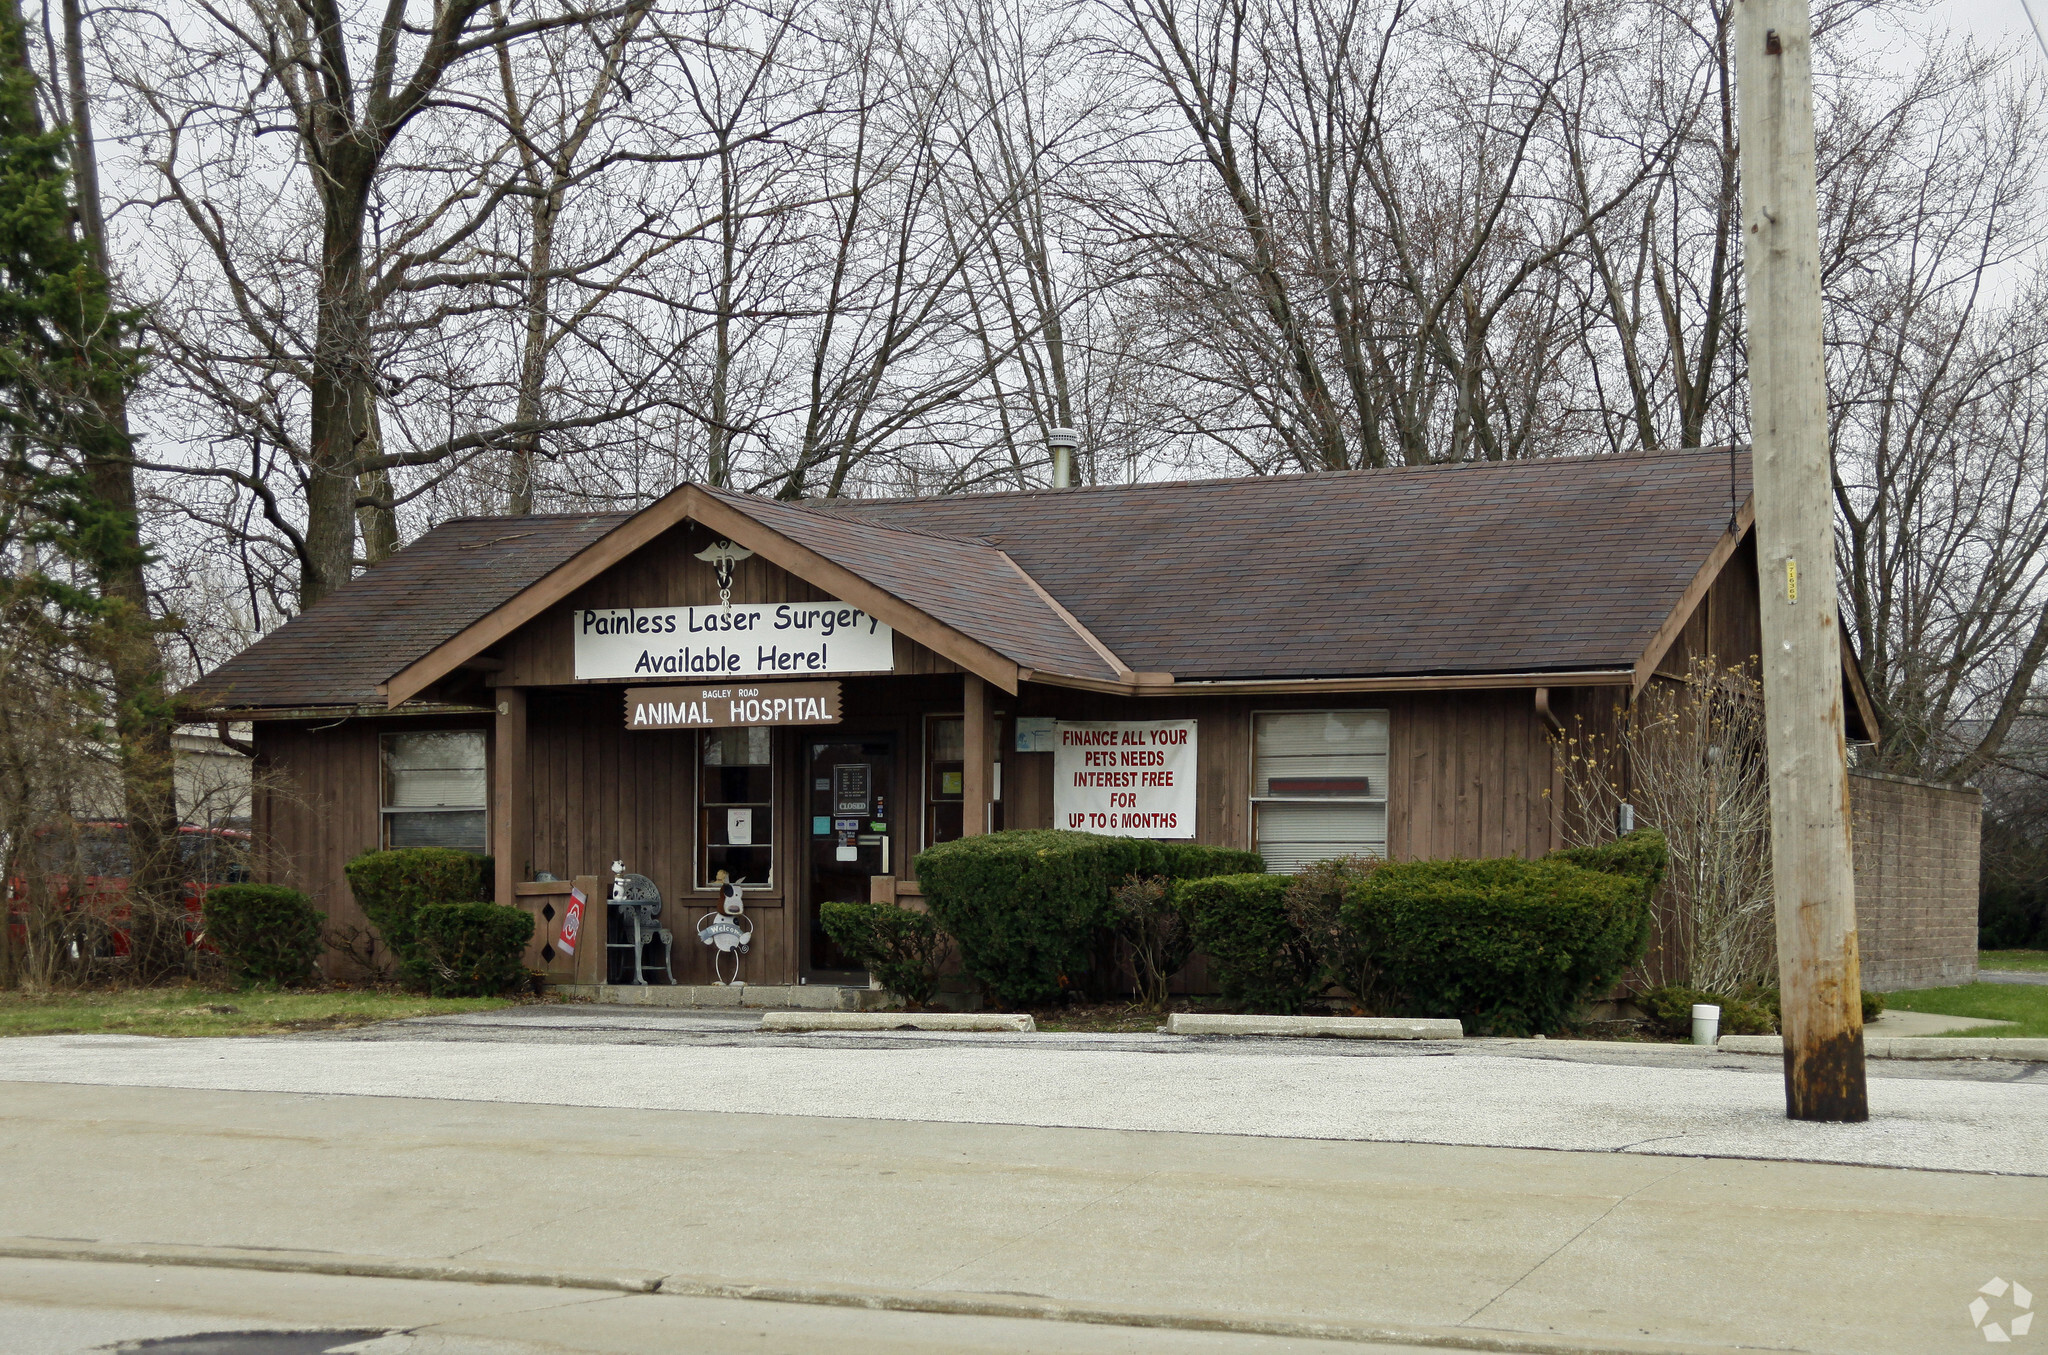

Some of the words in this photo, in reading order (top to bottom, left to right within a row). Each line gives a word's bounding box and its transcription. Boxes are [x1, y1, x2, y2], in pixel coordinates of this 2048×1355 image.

[583, 608, 676, 635] Painless
[688, 606, 760, 632] Laser
[635, 646, 740, 674] Available
[758, 643, 826, 670] Here!
[703, 690, 731, 698] BAGLEY
[739, 689, 758, 697] ROAD
[634, 701, 713, 725] ANIMAL
[730, 697, 832, 722] HOSPITAL
[1062, 730, 1118, 746] FINANCE
[1121, 731, 1146, 746] ALL
[1151, 729, 1187, 745] YOUR
[1085, 751, 1117, 767] PETS
[1121, 751, 1164, 766] NEEDS
[1074, 772, 1137, 787] INTEREST
[1141, 771, 1174, 787] FREE
[839, 802, 866, 810] CLOSED
[1111, 793, 1136, 808] FOR
[1068, 813, 1085, 829] UP
[1089, 813, 1106, 828] TO
[1110, 812, 1118, 828] 6
[1121, 812, 1178, 829] MONTHS
